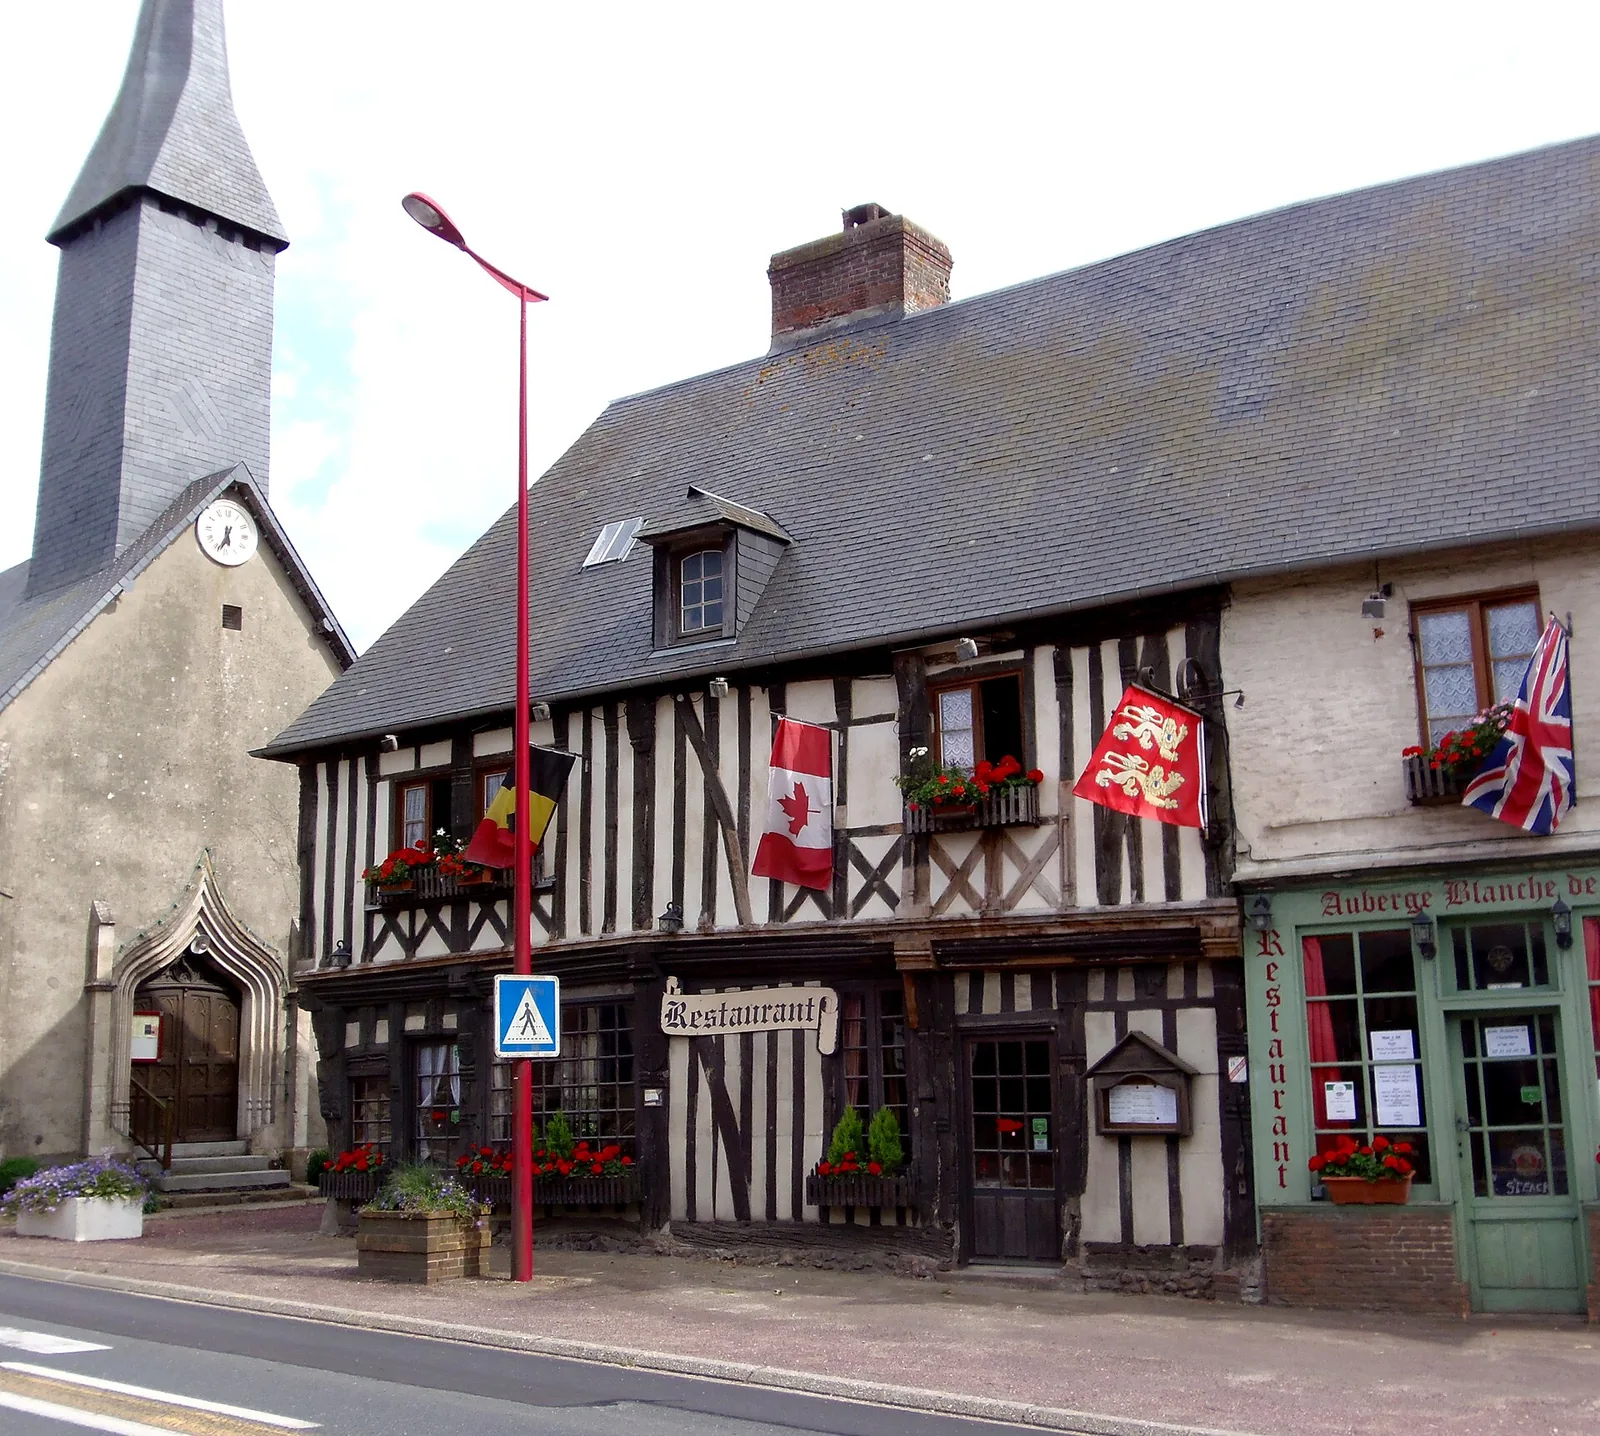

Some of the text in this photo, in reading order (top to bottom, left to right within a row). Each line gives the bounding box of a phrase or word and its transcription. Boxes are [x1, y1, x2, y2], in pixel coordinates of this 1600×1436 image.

[1321, 871, 1597, 917] Auberge Blanche de
[664, 996, 816, 1029] Restaurant
[1256, 929, 1290, 1189] Restaurant
